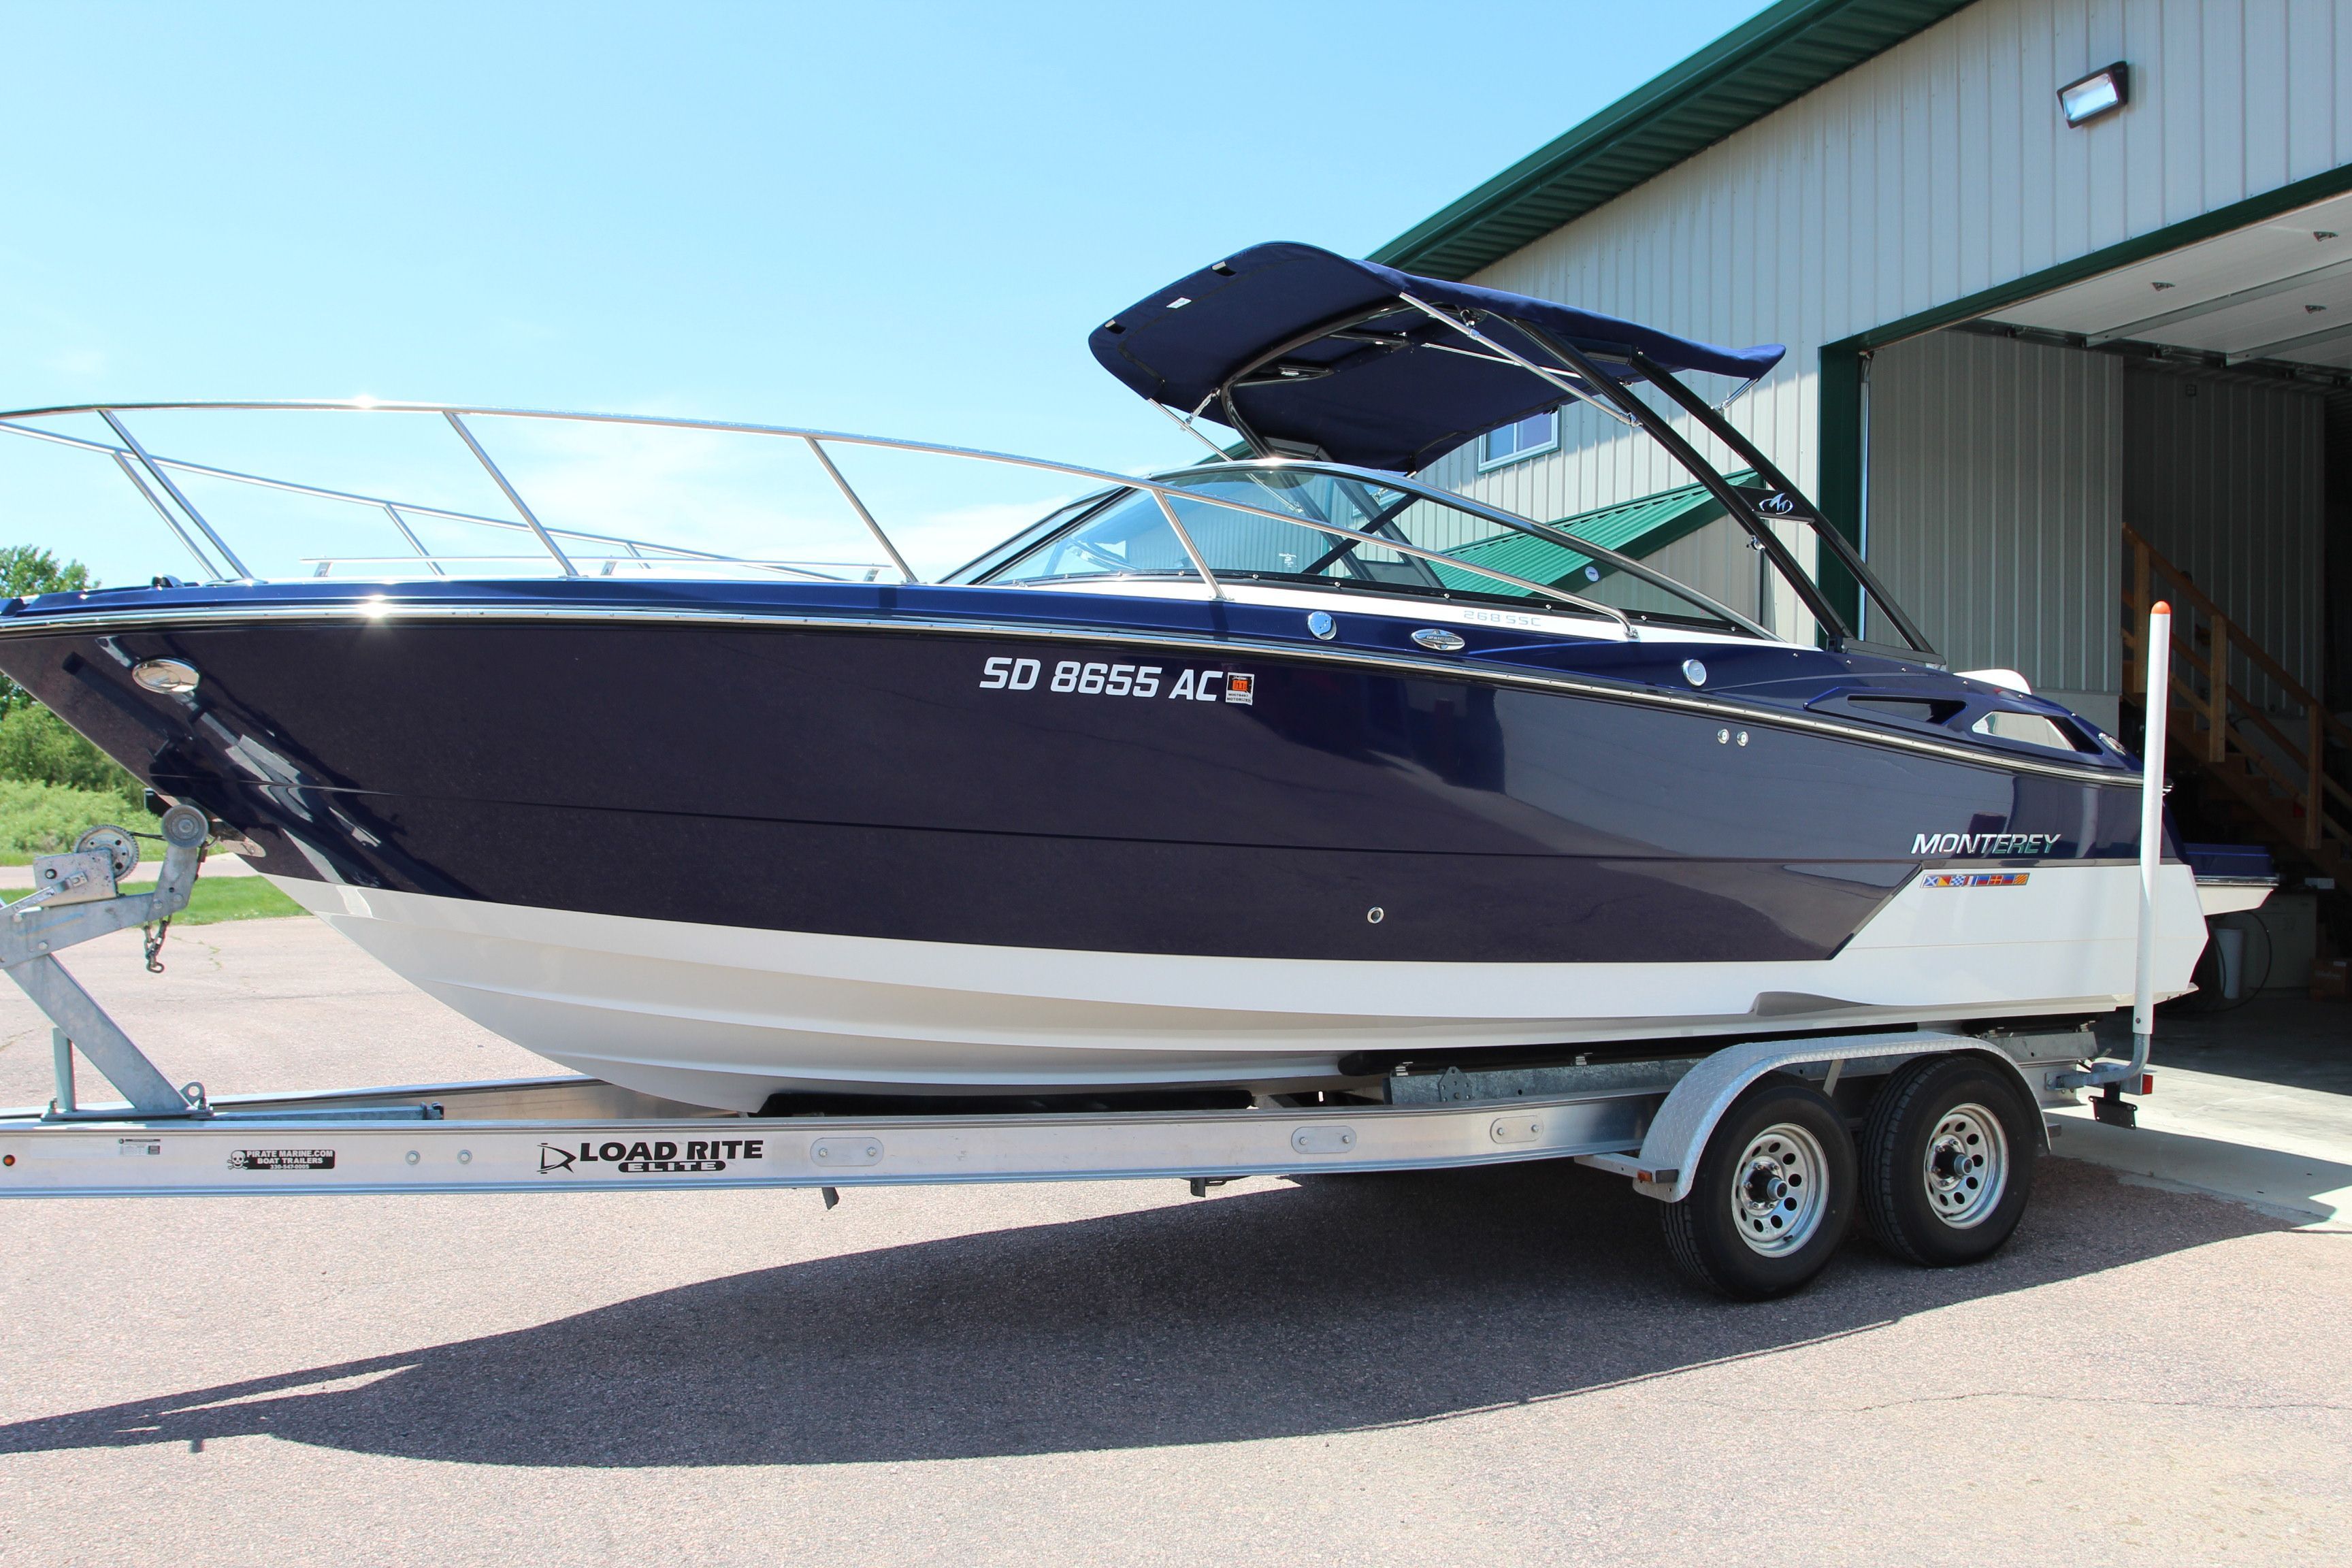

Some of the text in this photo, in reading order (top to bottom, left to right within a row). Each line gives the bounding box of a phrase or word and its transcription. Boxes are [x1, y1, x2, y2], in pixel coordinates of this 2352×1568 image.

[1464, 610, 1541, 626] 268 SSC
[979, 657, 1223, 701] SD 8655 AC
[1911, 833, 2061, 854] MONTEREY
[580, 1140, 764, 1161] LOAD RITE
[627, 1162, 717, 1171] ELITE
